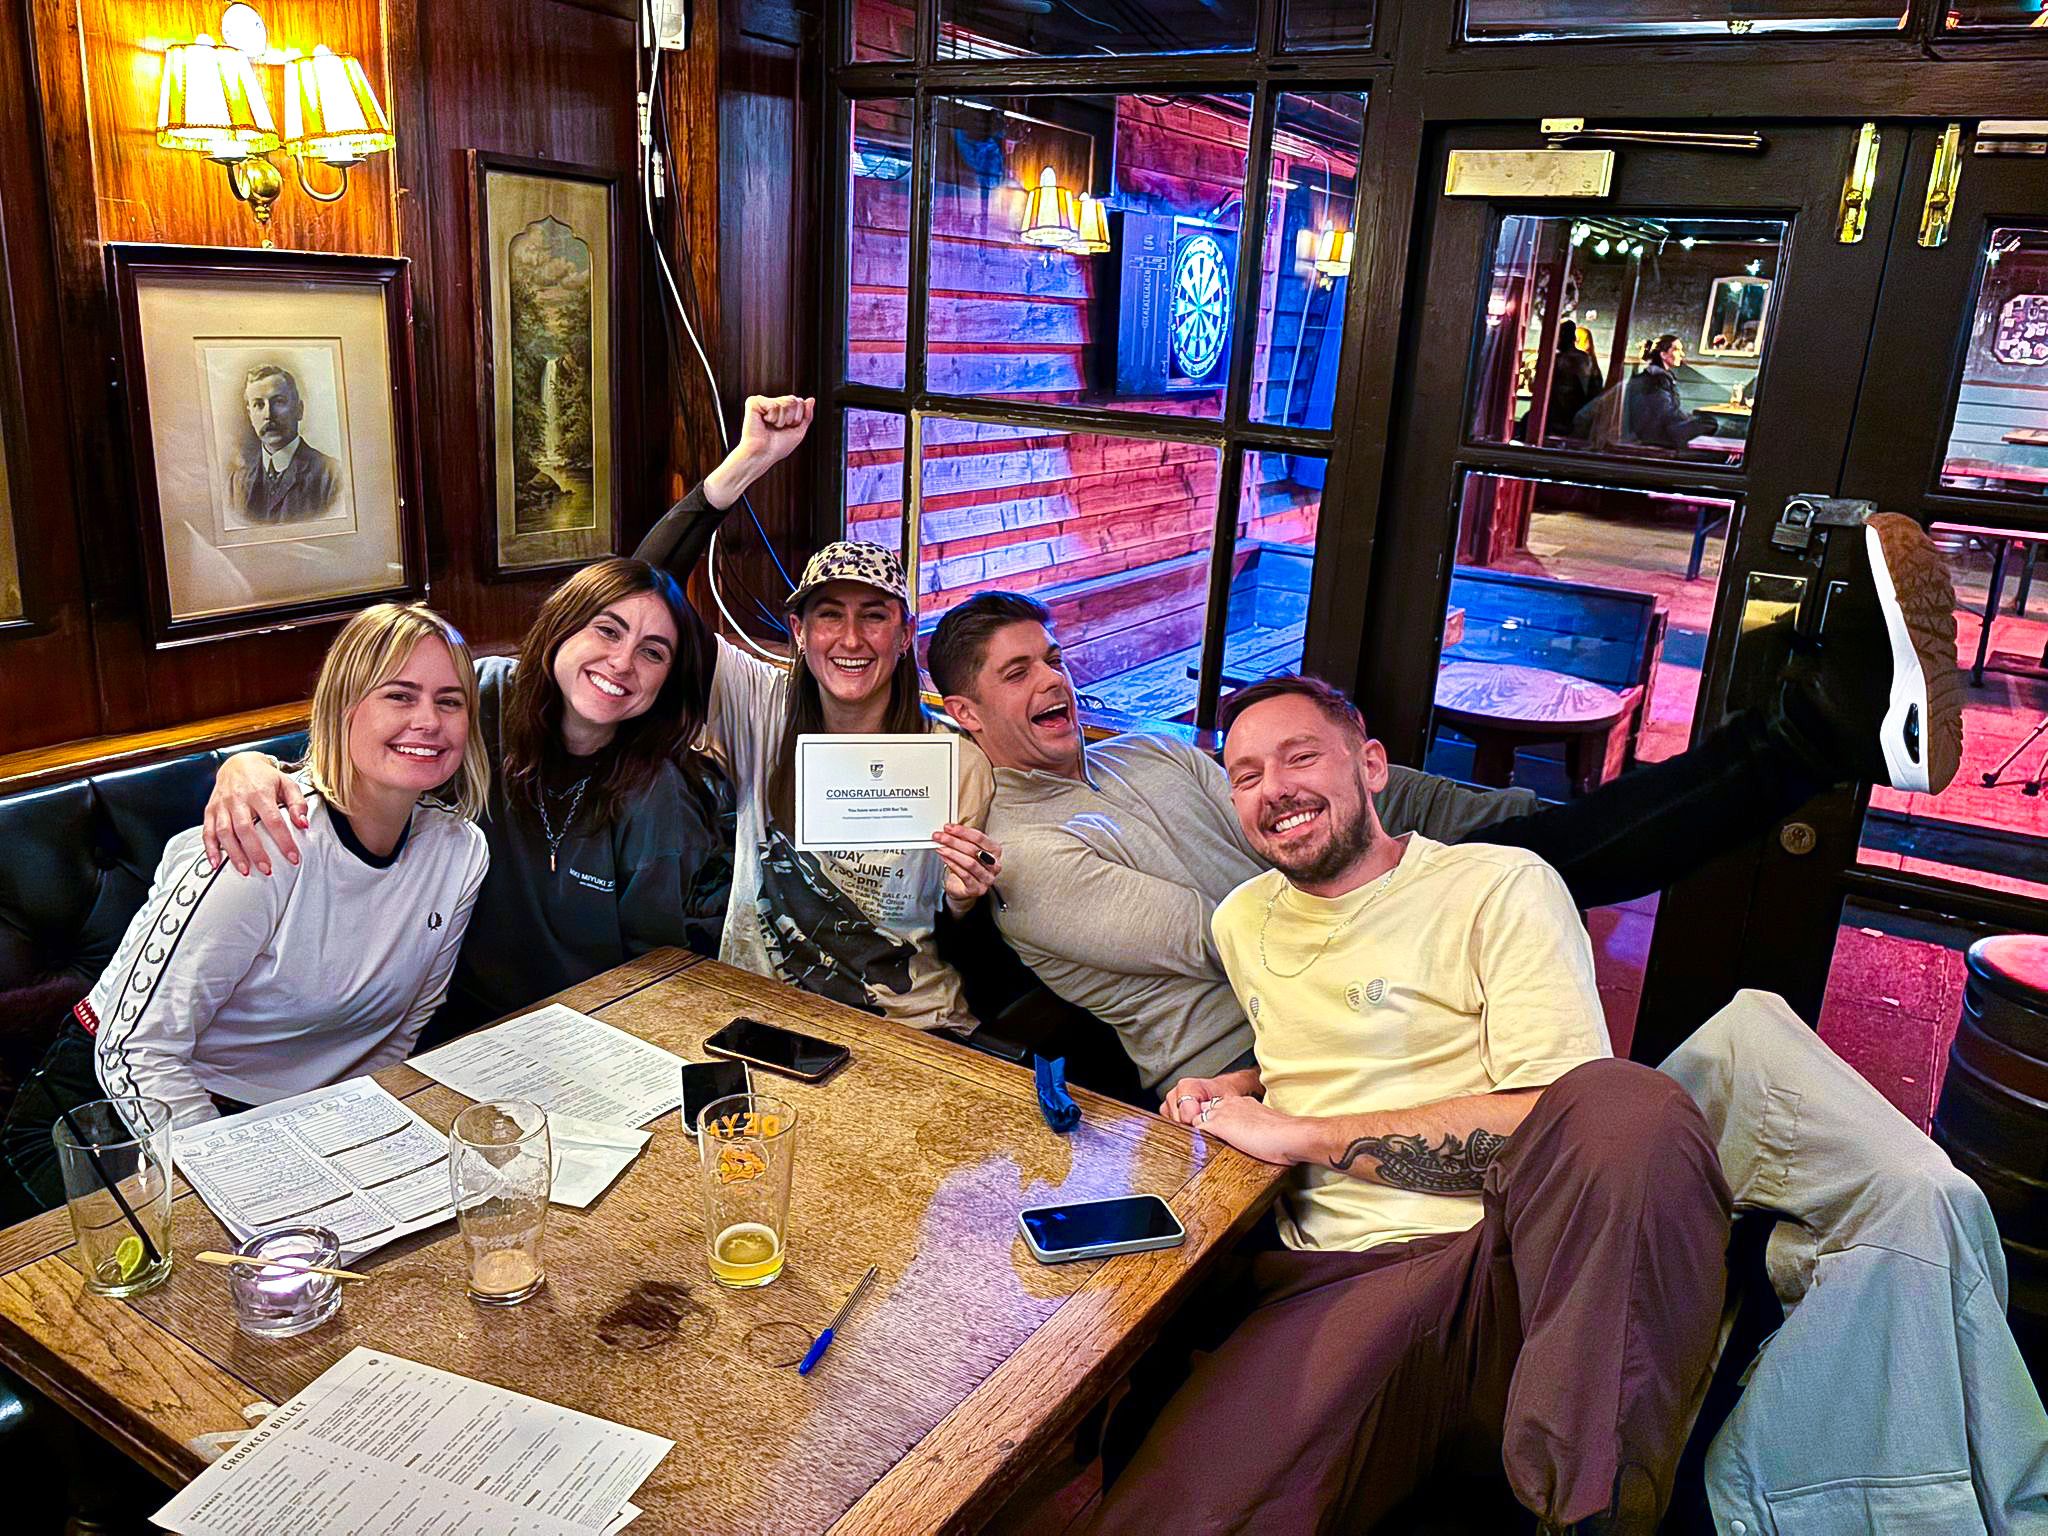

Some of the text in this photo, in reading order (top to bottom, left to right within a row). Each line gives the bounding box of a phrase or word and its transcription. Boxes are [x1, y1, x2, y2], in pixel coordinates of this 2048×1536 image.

[826, 785, 929, 799] CONGRATULATIONS!
[853, 863, 904, 880] JUNE 4
[221, 1430, 271, 1471] CROOKED
[269, 1401, 307, 1430] BILLET
